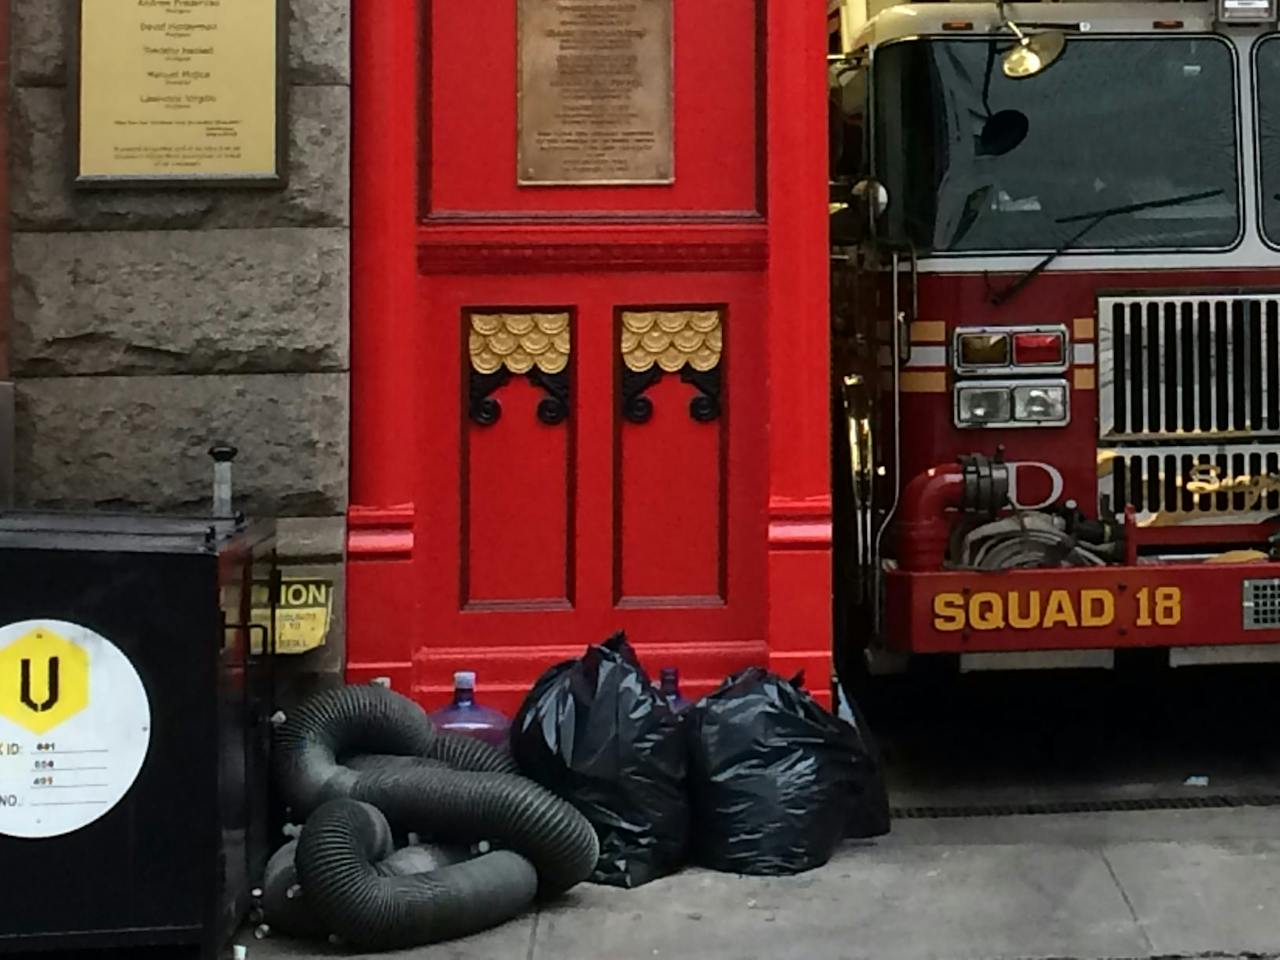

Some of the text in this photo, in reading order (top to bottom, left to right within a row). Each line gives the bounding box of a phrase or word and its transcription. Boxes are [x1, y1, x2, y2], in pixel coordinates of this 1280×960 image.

[280, 584, 326, 606] ION
[933, 586, 1182, 631] SQUAD 18
[20, 656, 60, 713] U
